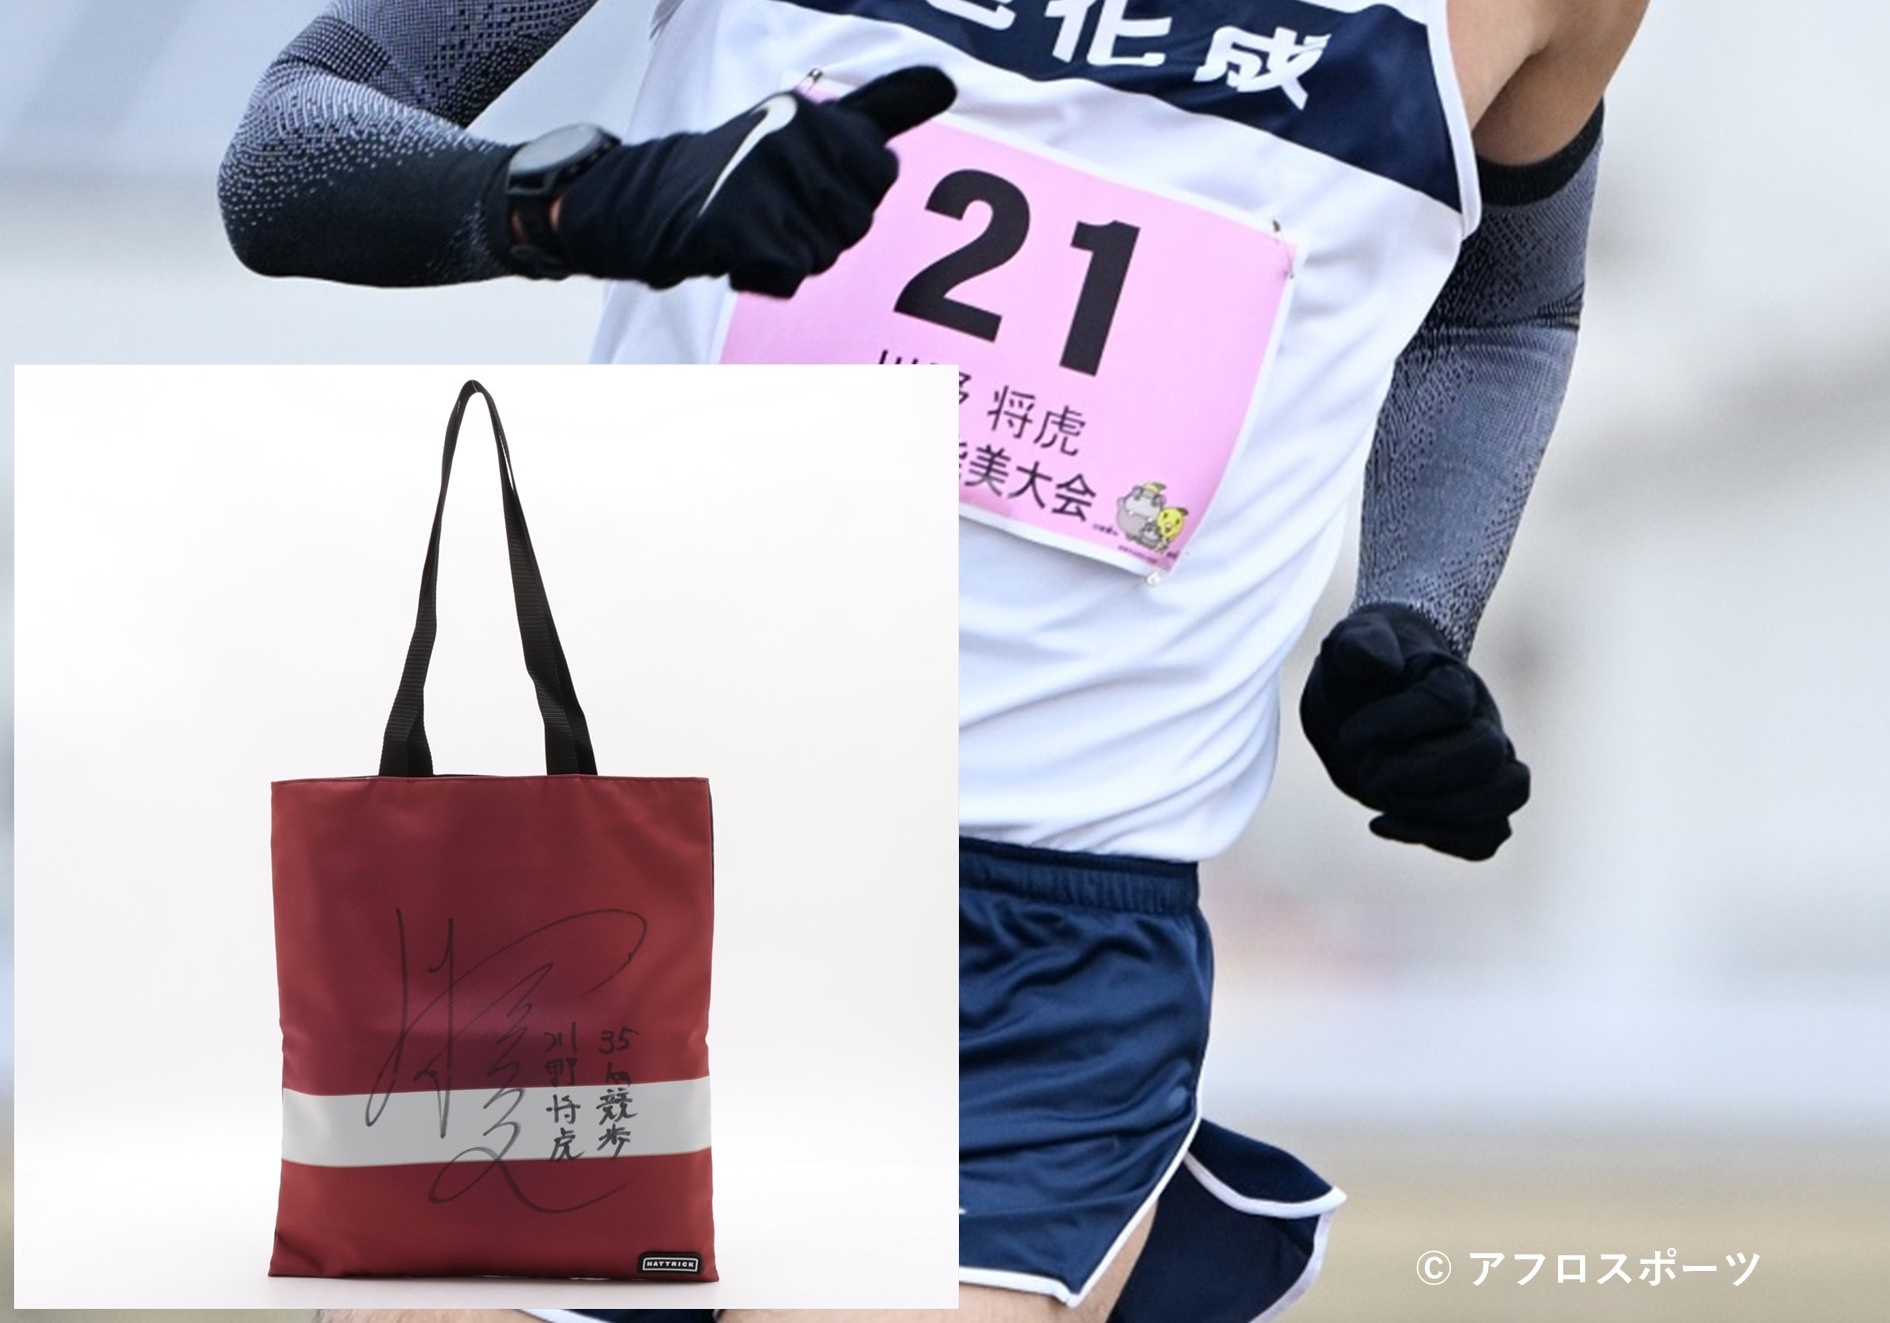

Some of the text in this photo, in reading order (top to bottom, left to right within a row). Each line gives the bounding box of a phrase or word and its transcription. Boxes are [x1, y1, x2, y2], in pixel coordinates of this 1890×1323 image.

[893, 168, 1141, 377] 21
[986, 384, 1086, 456] 将虎
[544, 1021, 585, 1162] 川野将虎
